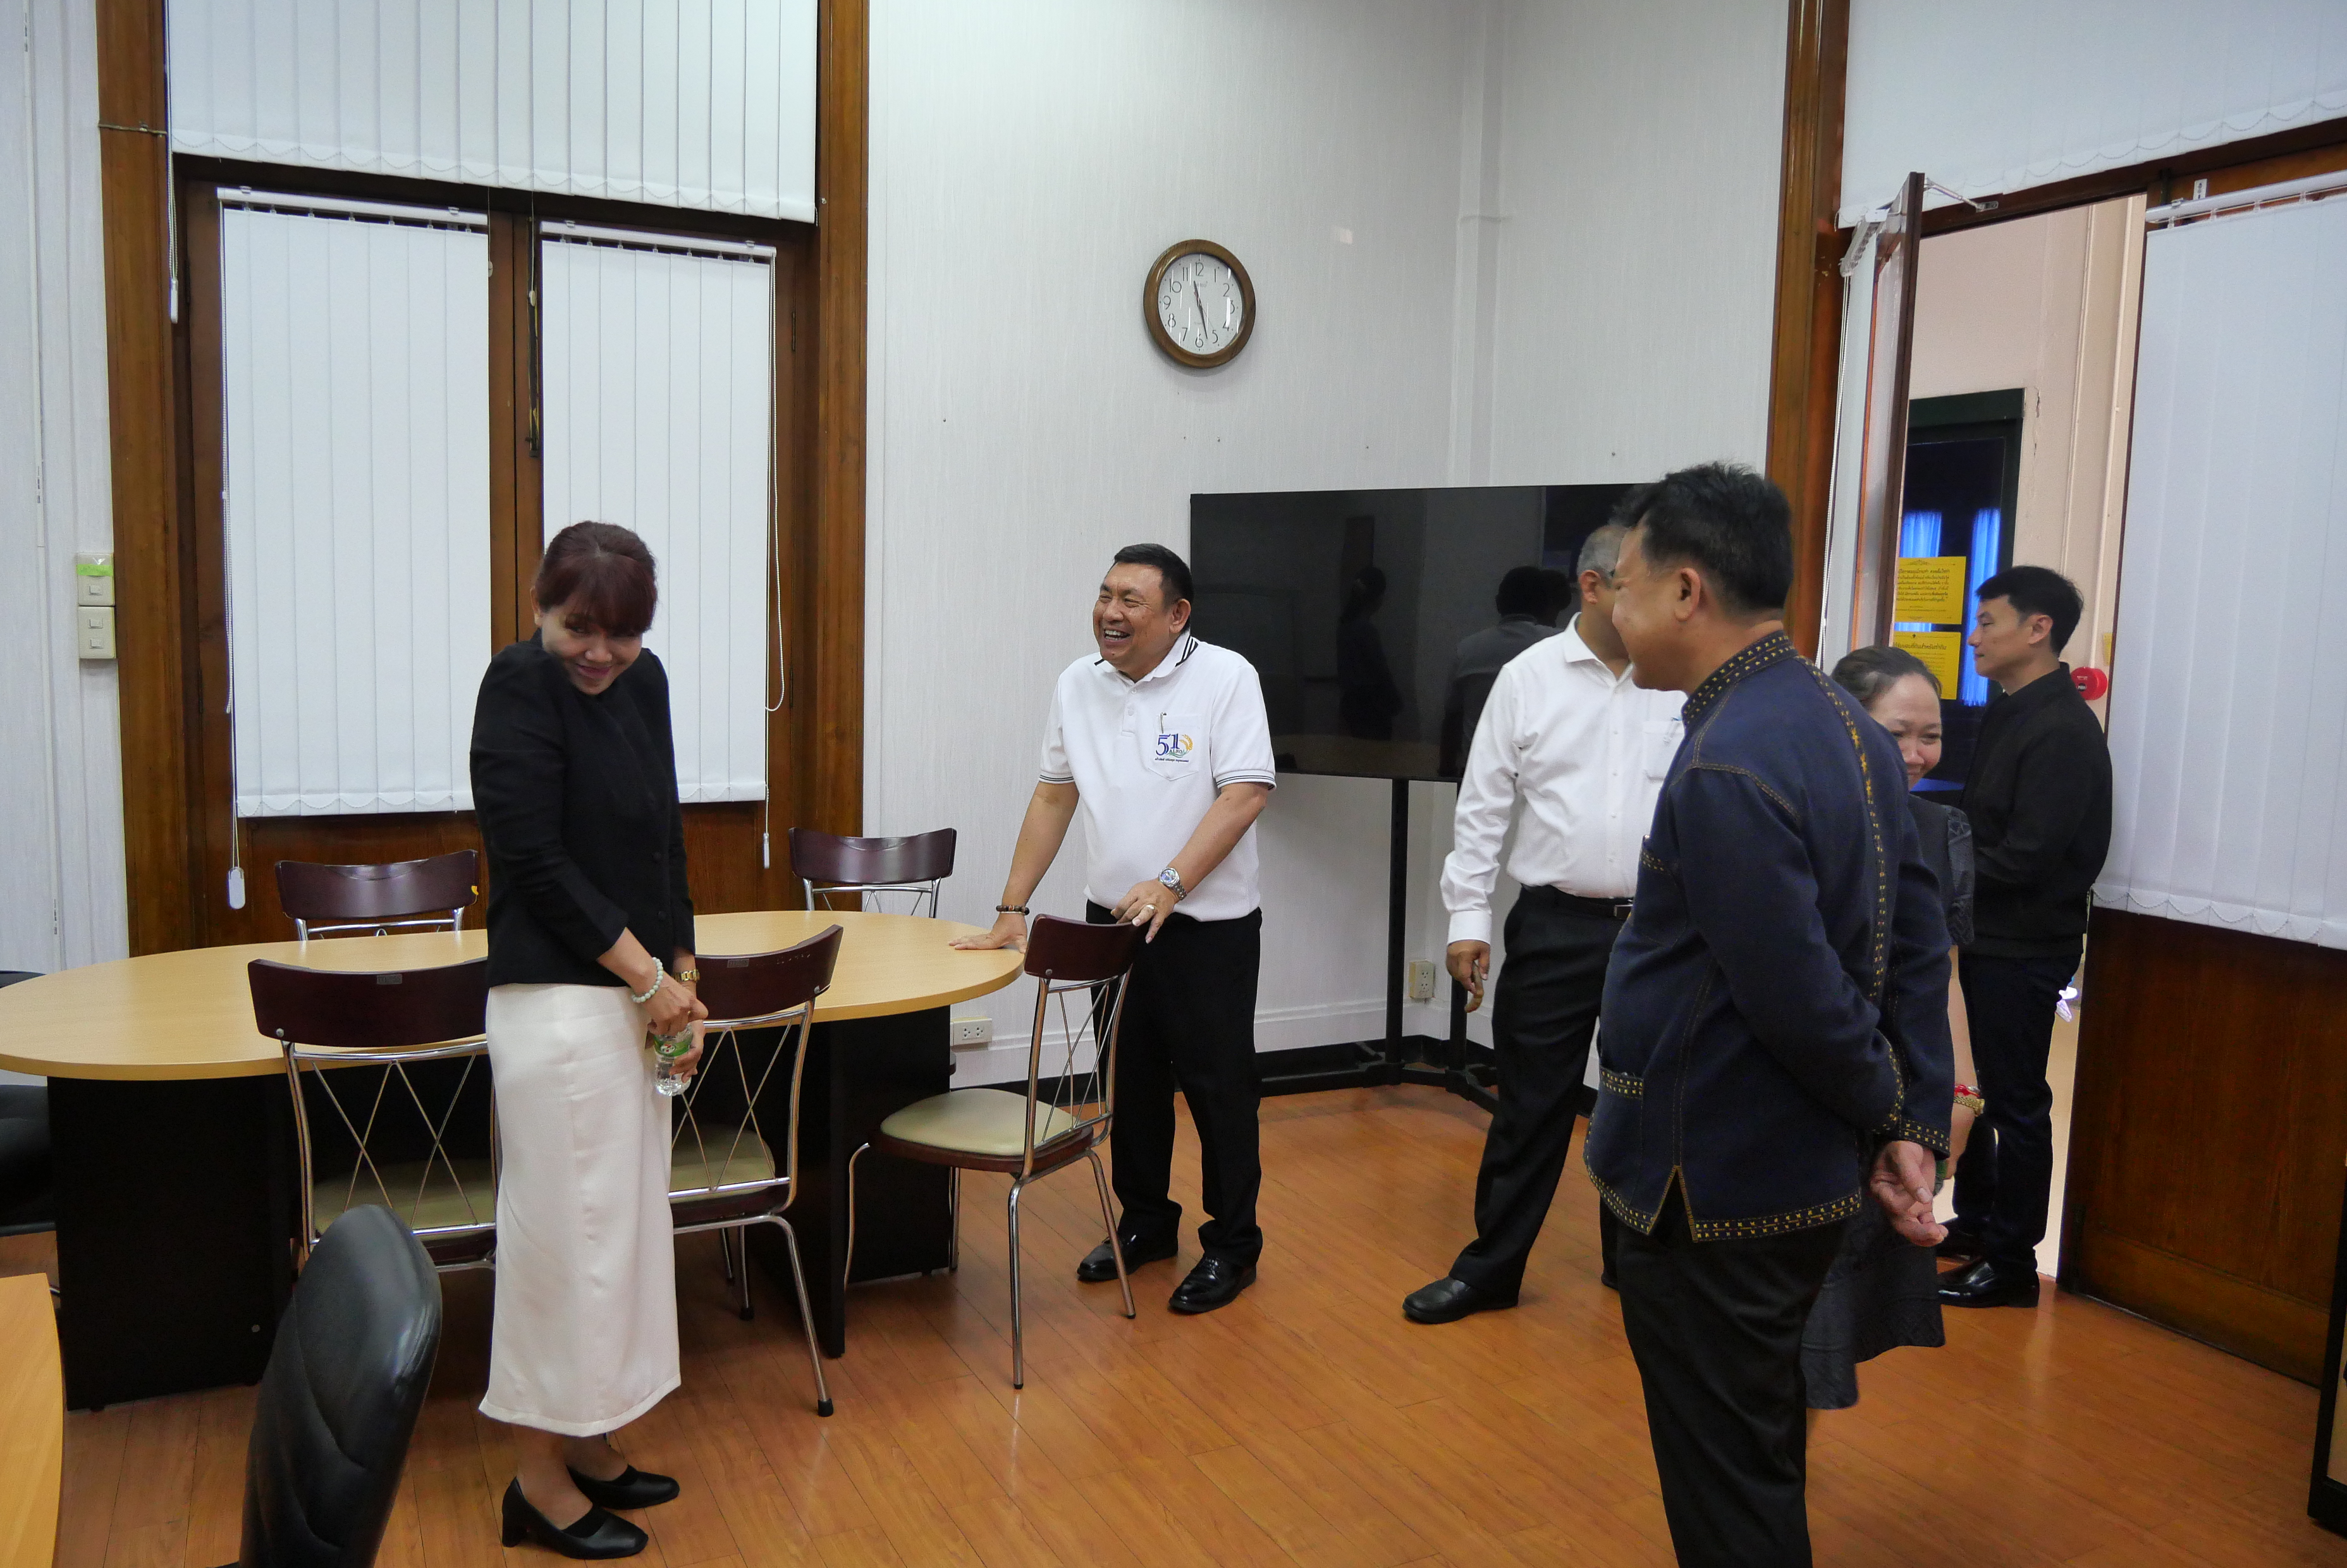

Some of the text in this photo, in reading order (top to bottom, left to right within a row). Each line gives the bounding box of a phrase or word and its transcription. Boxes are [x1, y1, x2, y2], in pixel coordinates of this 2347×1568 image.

[1182, 267, 1189, 281] 11
[1195, 262, 1204, 276] 12
[1170, 278, 1182, 293] 10
[1223, 283, 1230, 297] 2
[1163, 295, 1171, 310] 9
[1229, 300, 1235, 314] 3
[1168, 313, 1176, 328] 8
[1223, 318, 1230, 331] 4
[1182, 327, 1188, 341] 7
[1195, 333, 1204, 348] 6
[1212, 329, 1218, 344] 5
[1156, 733, 1180, 756] 51
